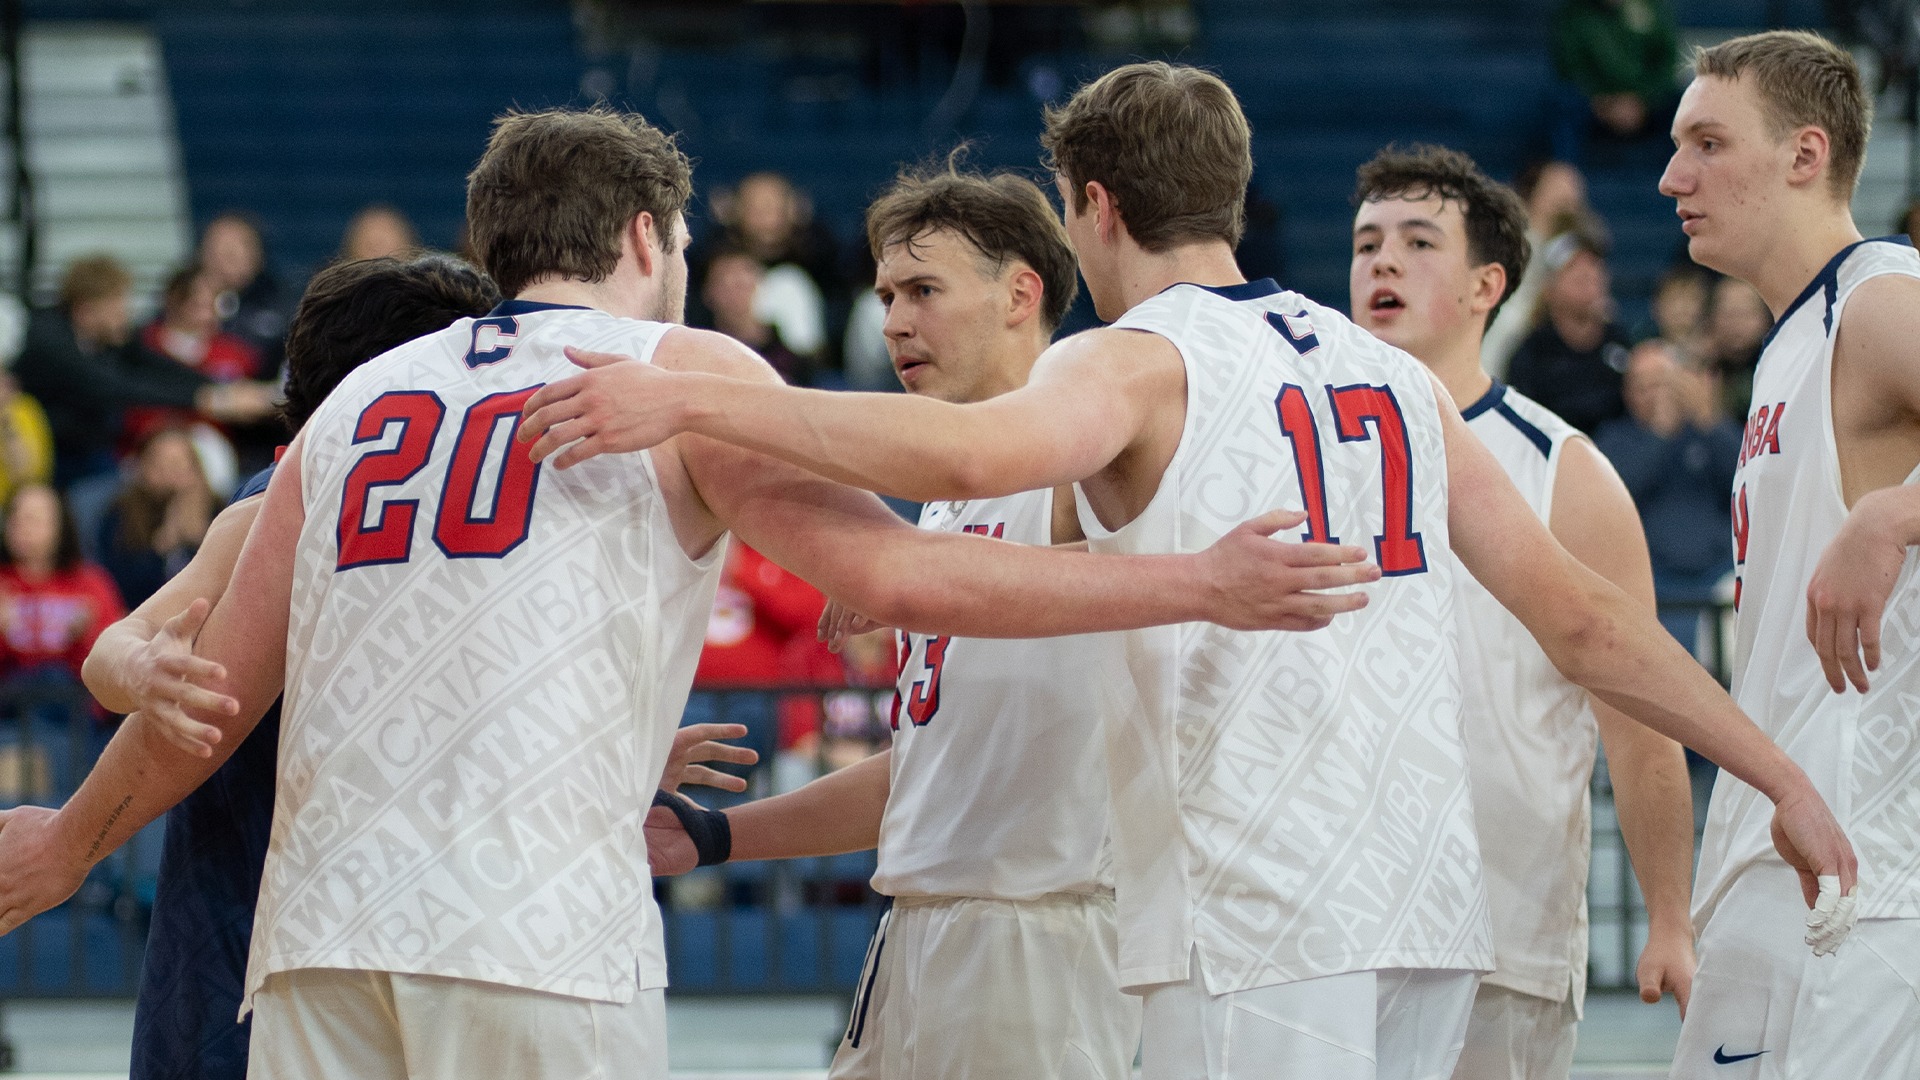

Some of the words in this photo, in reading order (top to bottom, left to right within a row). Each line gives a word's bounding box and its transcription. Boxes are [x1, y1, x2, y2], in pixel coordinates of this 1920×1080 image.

[462, 315, 519, 370] C
[335, 382, 549, 573] 20
[1274, 381, 1429, 579] 17
[376, 558, 608, 769] CATAWBA
[1222, 693, 1388, 934] CATAWBA
[1297, 757, 1446, 975] CATAWBA
